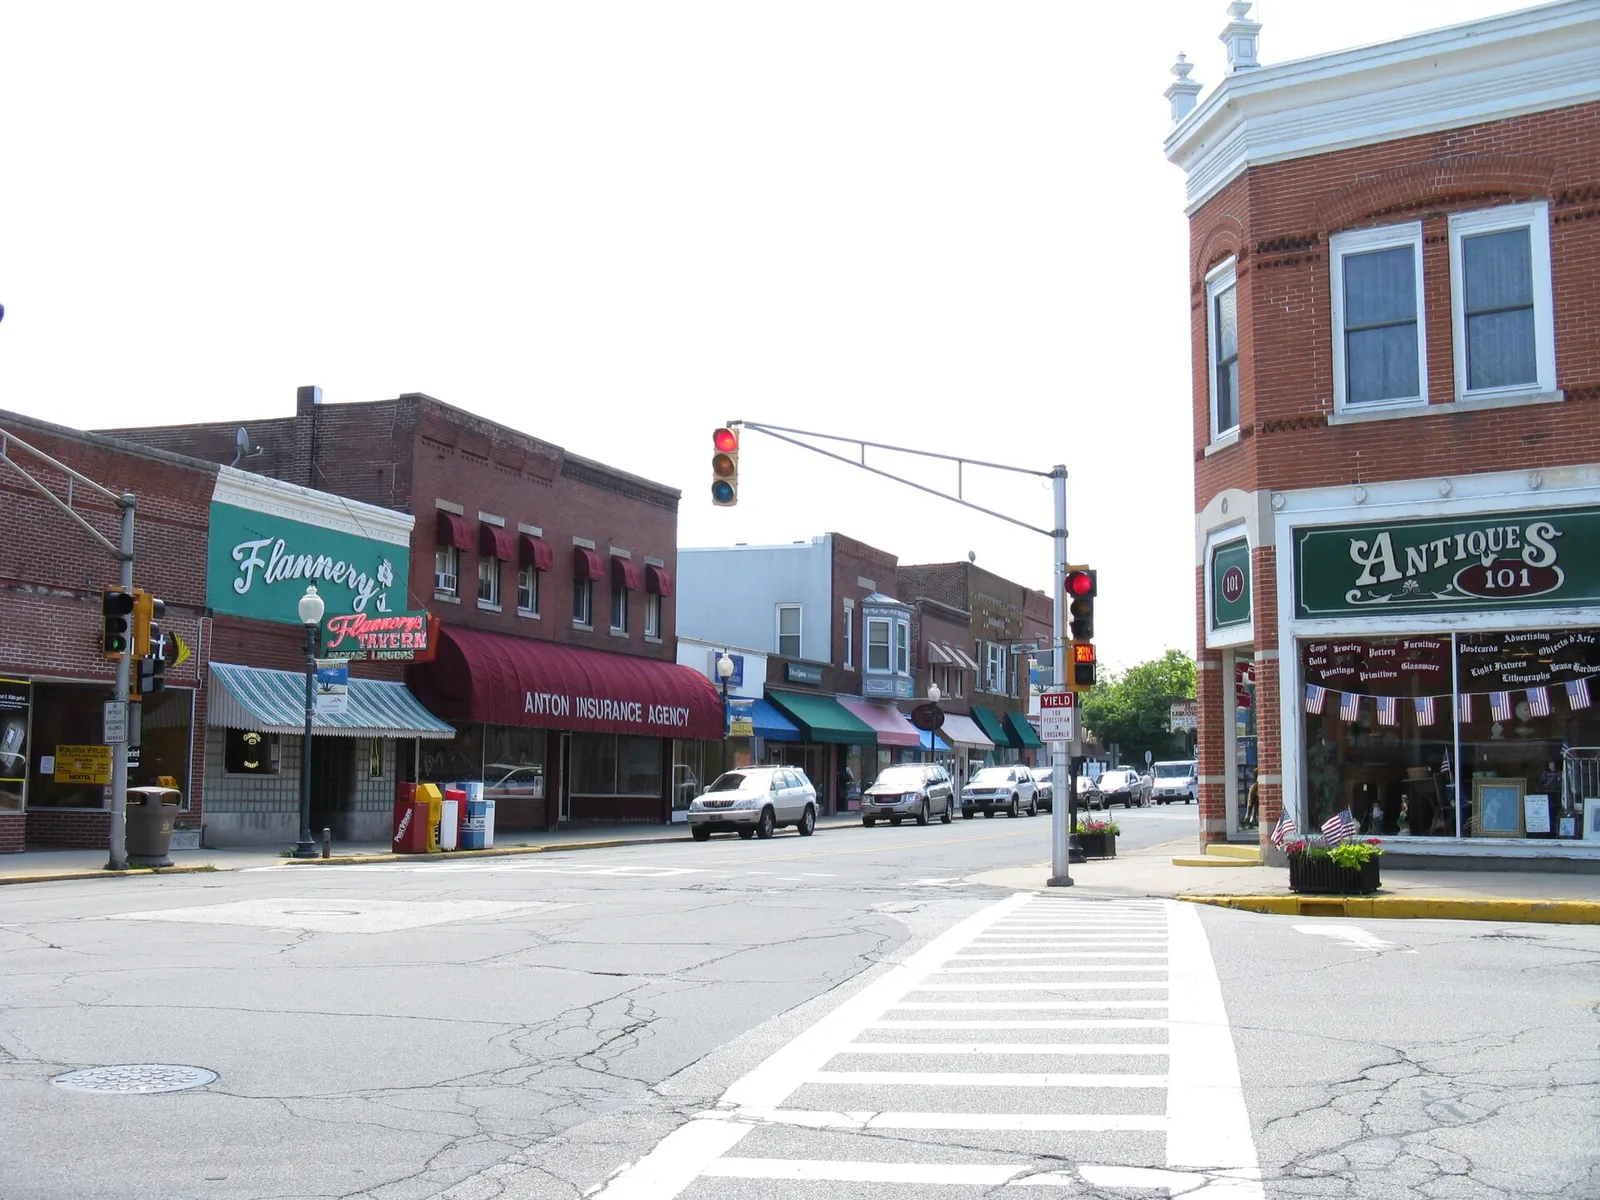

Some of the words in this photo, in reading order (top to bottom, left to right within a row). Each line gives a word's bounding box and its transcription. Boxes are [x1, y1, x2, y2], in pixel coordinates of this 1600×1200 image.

[1349, 521, 1564, 586] ANTIQUES
[1226, 574, 1238, 593] 101
[1485, 568, 1530, 589] 101
[358, 631, 427, 649] TAVERN
[1503, 631, 1550, 644] Advertising
[1309, 643, 1327, 653] Toys
[1333, 642, 1361, 654] Jewelry
[1403, 640, 1441, 650] Furniture
[1460, 643, 1498, 654] Postcards
[1538, 638, 1568, 656] Objects
[371, 650, 415, 661] LIQUORS
[1368, 646, 1396, 658] Pottery
[1309, 656, 1327, 666] Dolls
[1400, 661, 1440, 671] Glassware
[1319, 666, 1355, 679] Paintings
[1470, 664, 1492, 677] Light
[1494, 660, 1527, 671] Fixtures
[1549, 662, 1572, 673] Brass
[1359, 669, 1397, 682] Primitives
[1501, 671, 1551, 683] Lithographs
[1043, 695, 1070, 706] YIELD
[524, 691, 570, 717] ANTON
[576, 696, 642, 723] INSURANCE
[647, 704, 690, 727] AGENCY
[1044, 730, 1070, 738] CROSSWALK
[127, 749, 140, 758] print
